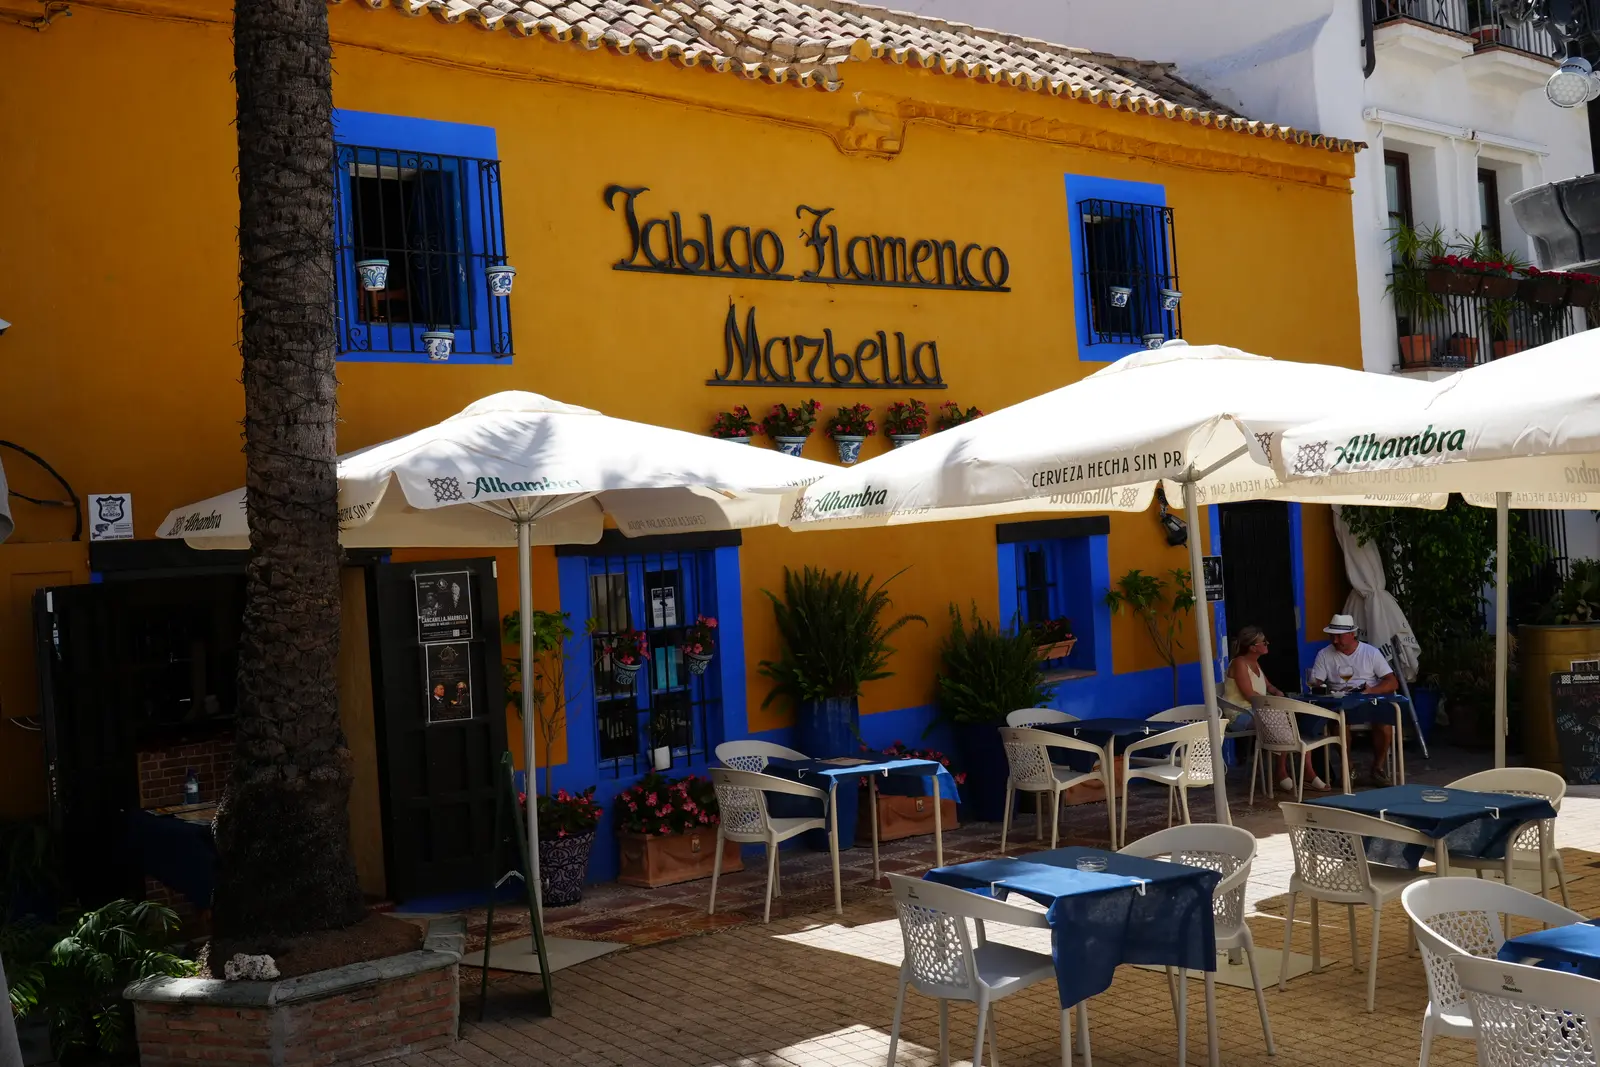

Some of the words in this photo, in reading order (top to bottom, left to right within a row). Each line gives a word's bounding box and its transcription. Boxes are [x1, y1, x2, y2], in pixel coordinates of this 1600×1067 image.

[603, 184, 784, 275] Tablao
[796, 204, 1010, 287] Flamenco
[714, 302, 942, 383] Marbella
[1330, 424, 1466, 469] Alhambra
[1032, 464, 1084, 488] CERVEZA
[1088, 457, 1130, 479] HECHA
[1134, 452, 1157, 472] SIN
[1164, 450, 1186, 468] PR
[184, 510, 221, 531] Alhambra
[812, 486, 888, 516] Alhambra
